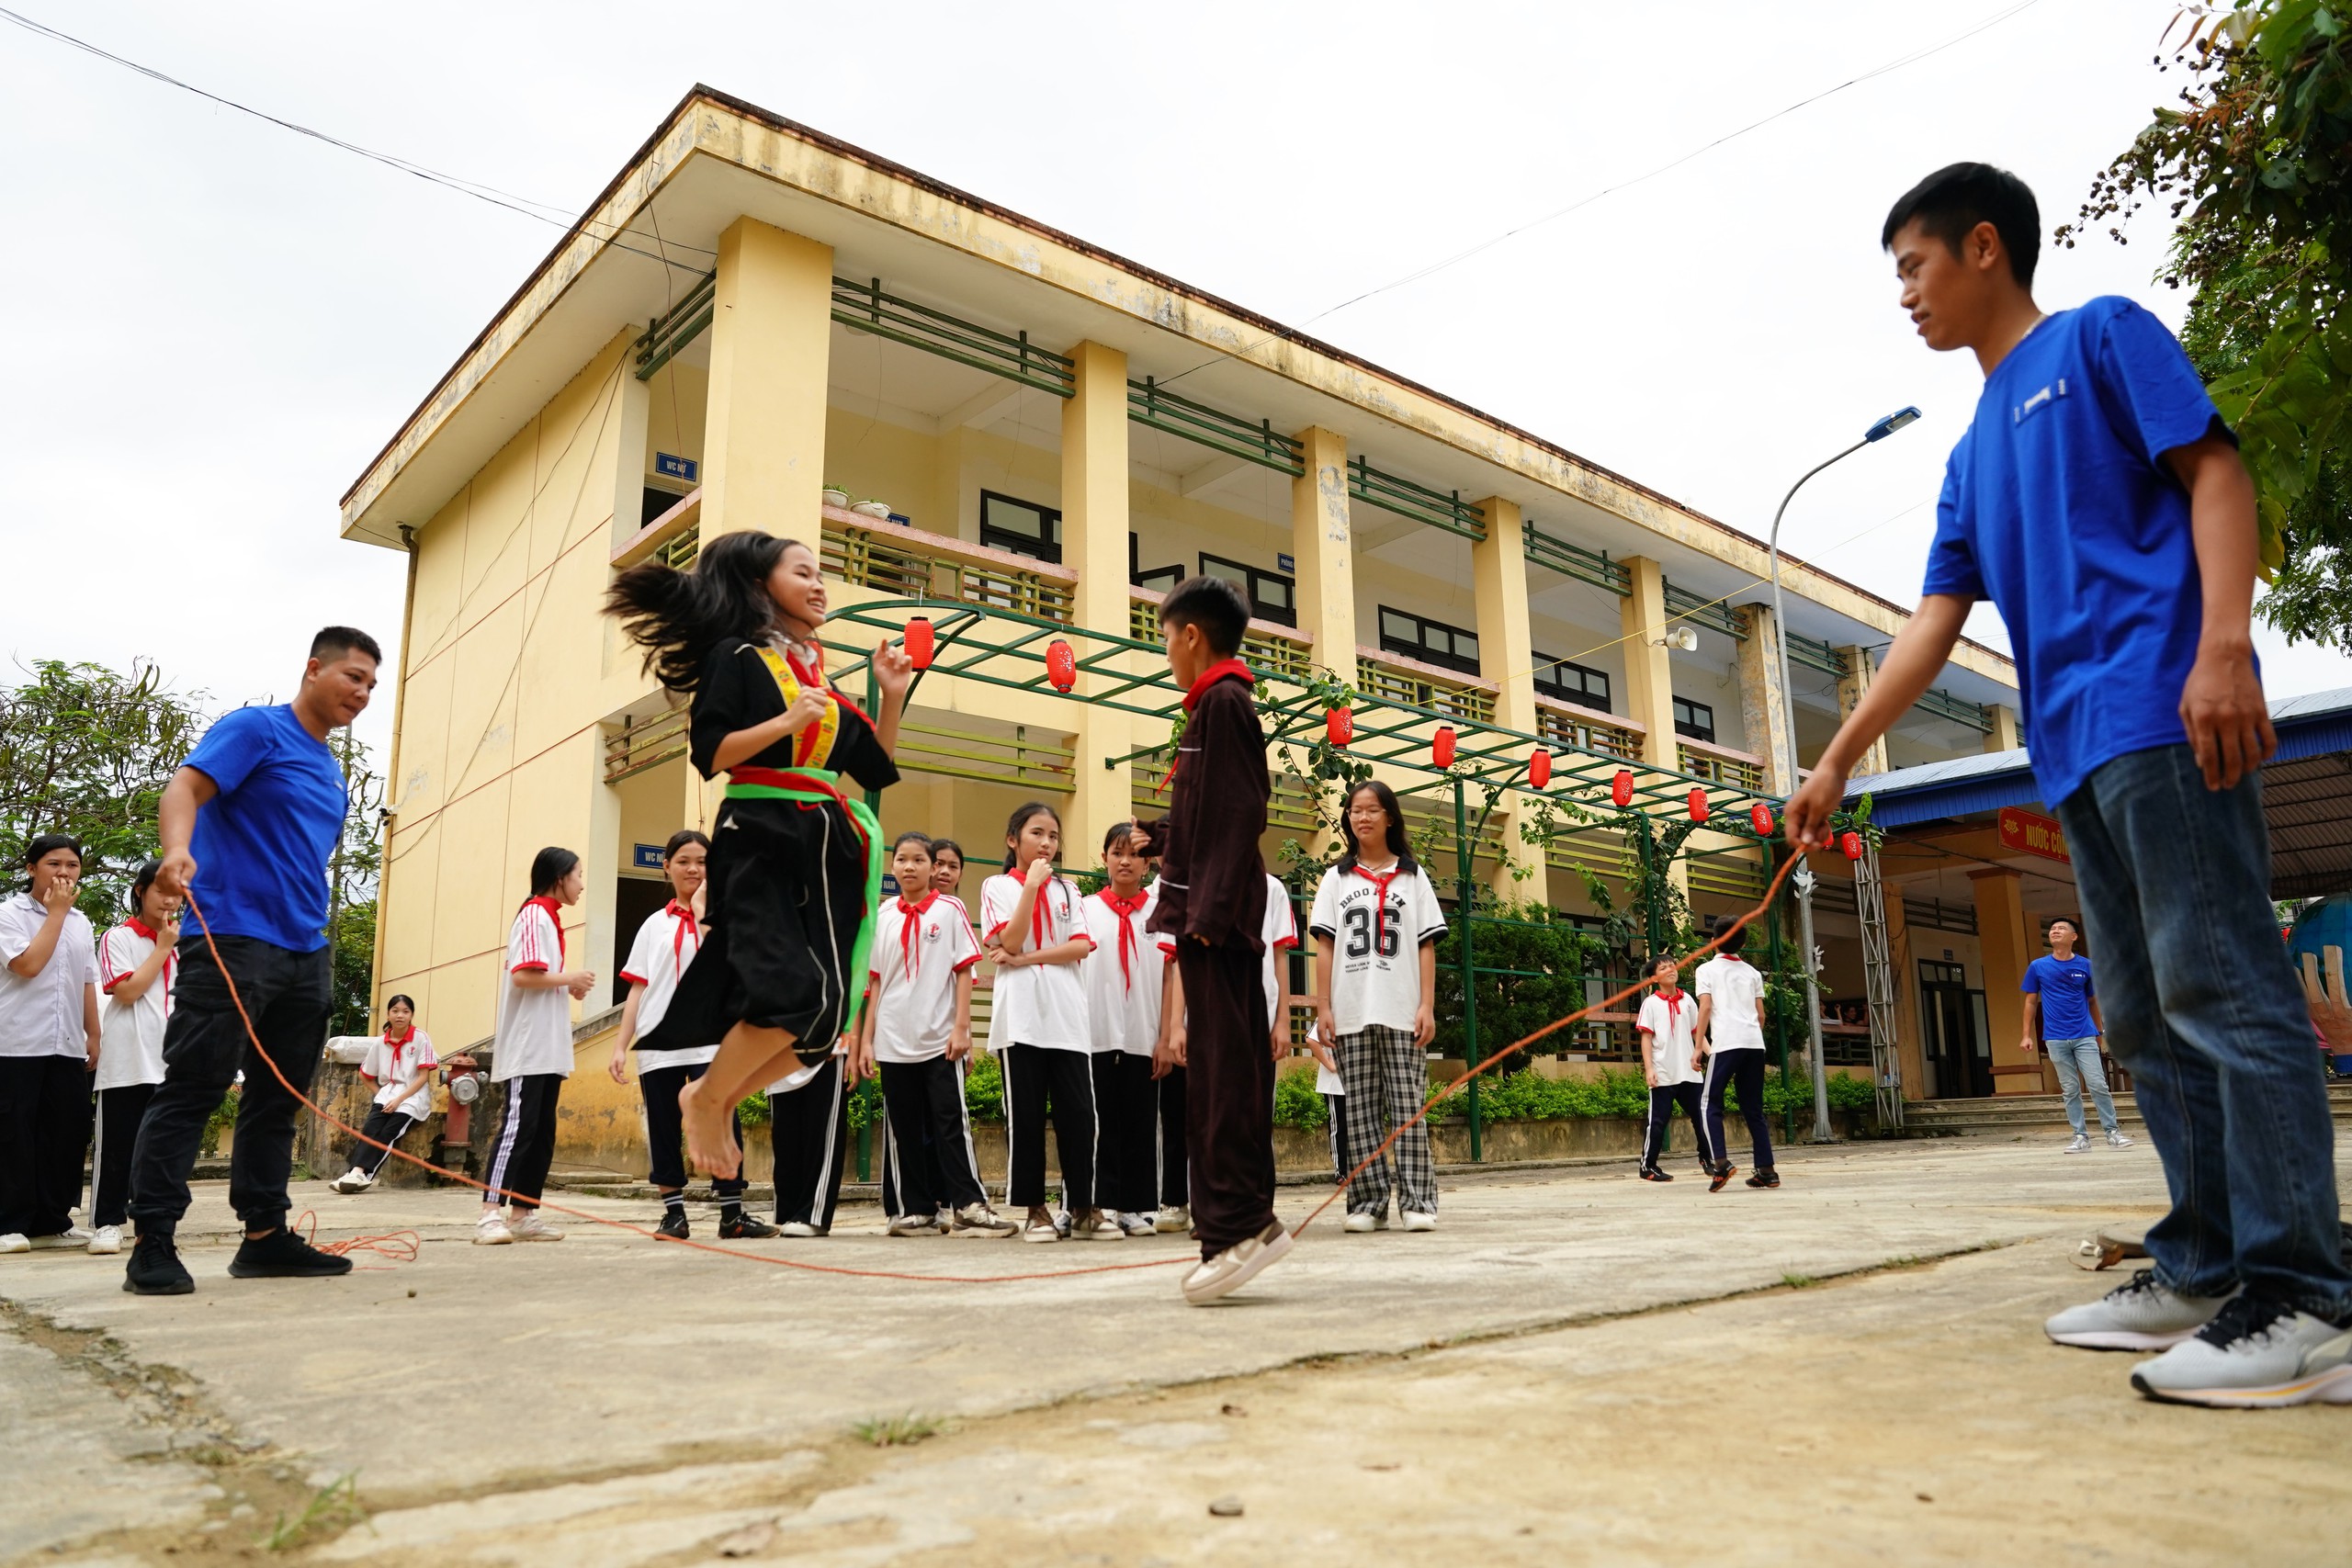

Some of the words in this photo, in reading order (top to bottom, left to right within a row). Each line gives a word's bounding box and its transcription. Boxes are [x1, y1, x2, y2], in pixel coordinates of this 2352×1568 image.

[666, 460, 676, 471] WC
[2026, 821, 2050, 852] NƯỚC
[2051, 829, 2071, 859] CỘN
[645, 852, 656, 863] WC
[883, 880, 896, 890] NAM
[1343, 905, 1402, 960] 36
